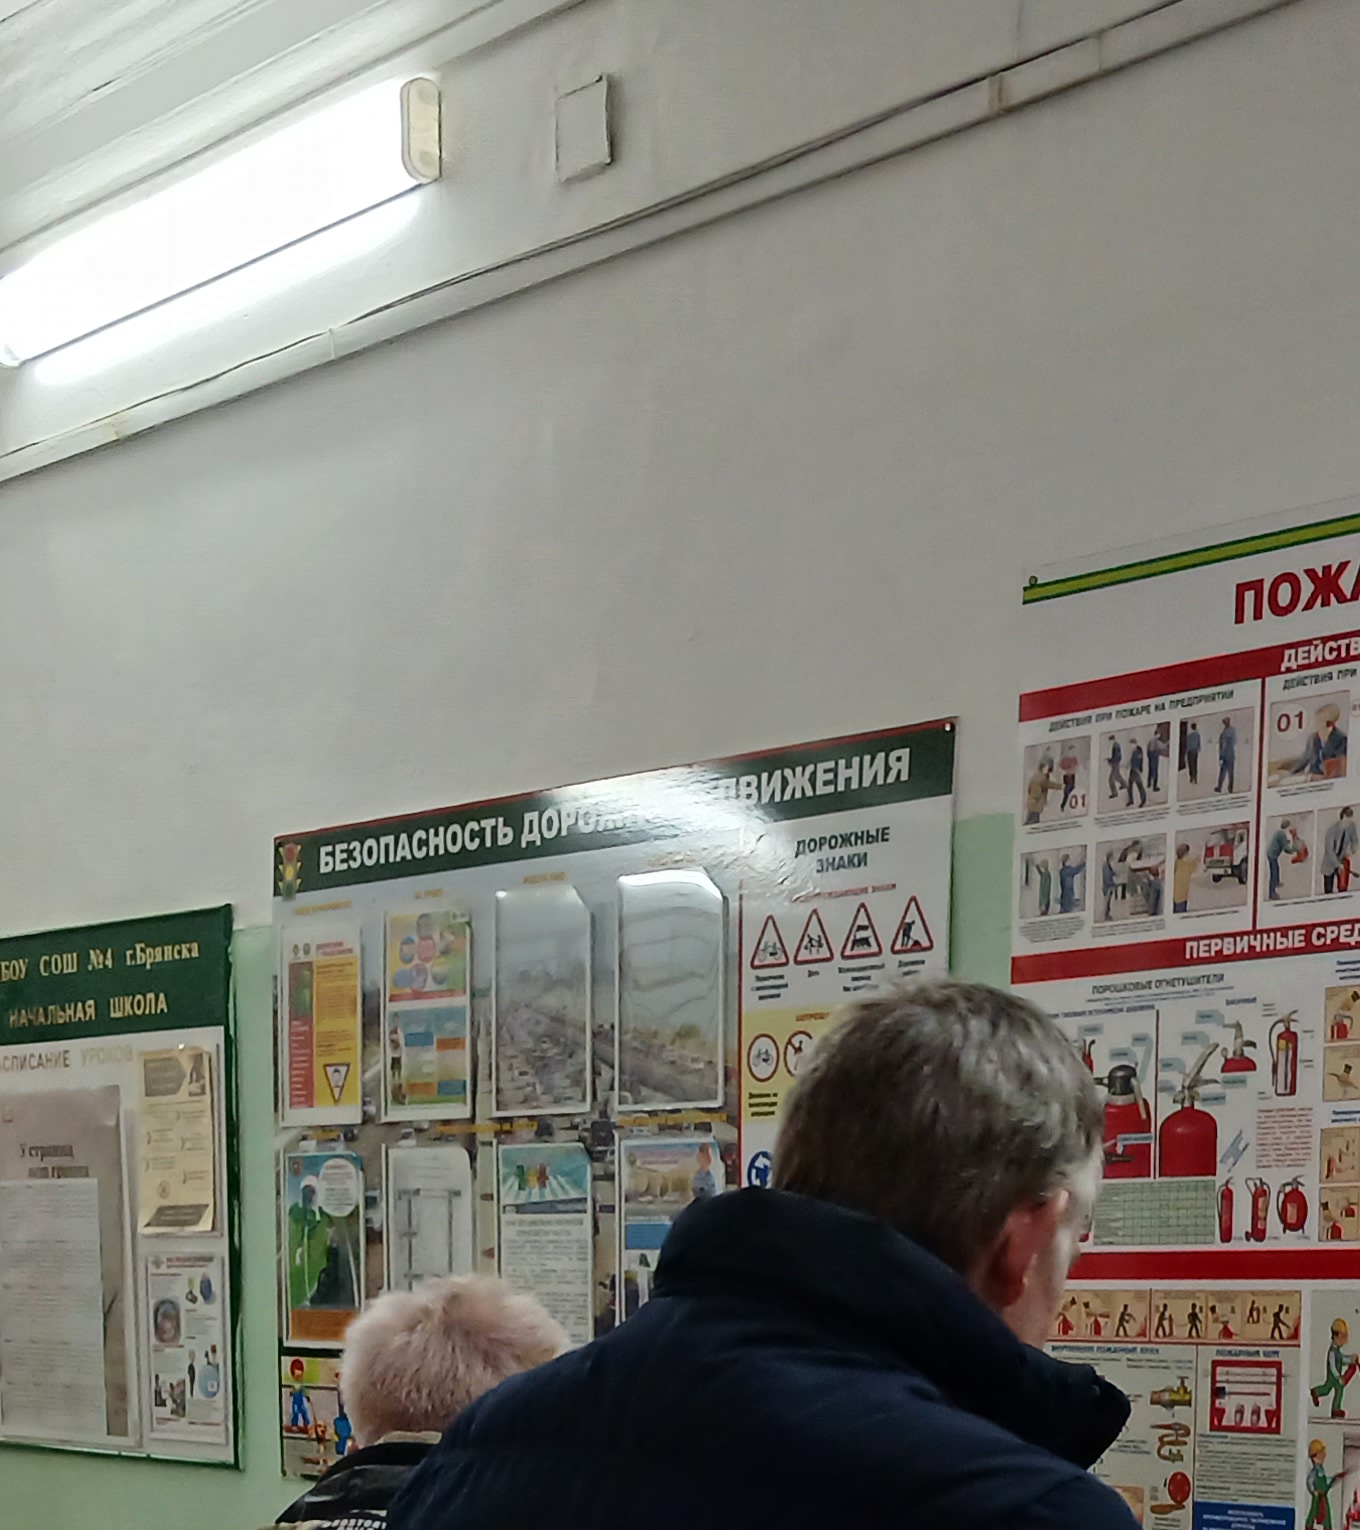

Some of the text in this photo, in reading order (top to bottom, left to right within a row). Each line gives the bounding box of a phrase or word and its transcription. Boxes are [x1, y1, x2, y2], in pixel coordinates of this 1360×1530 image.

[1283, 672, 1333, 690] ДЕЙСТВИЯ
[1337, 668, 1357, 680] ПРИ
[1115, 704, 1151, 719] ПОЖАРЕ
[1155, 702, 1166, 712] НА
[1169, 690, 1234, 709] ПРЕДПРИЯТИИ
[1277, 711, 1304, 732] 01
[318, 819, 515, 874] БЕЗОПАСНОСТЬ
[719, 748, 911, 806] ДВИЖЕНИЯ
[794, 827, 890, 859] ДОРОЖНЫЕ
[816, 852, 868, 874] ЗНАКИ
[1185, 928, 1306, 961] ПЕРВИЧНЫЕ
[40, 950, 79, 978] СОШ
[125, 942, 201, 973] г.Брянска
[1092, 979, 1152, 995] ПОРОШКОВЫЕ
[8, 992, 168, 1030] НАЧАЛЬНАЯ ШКОЛА
